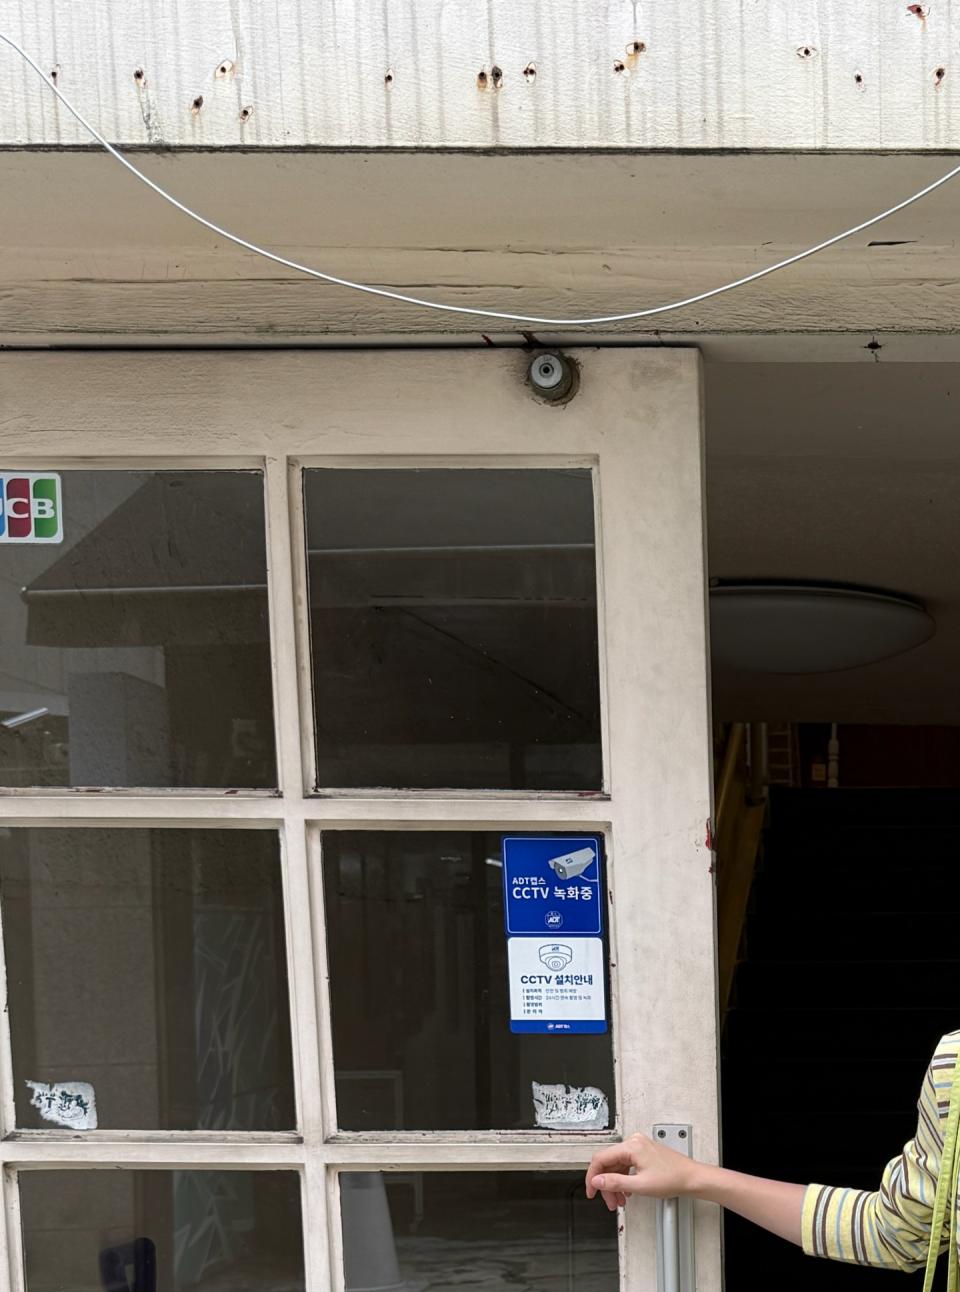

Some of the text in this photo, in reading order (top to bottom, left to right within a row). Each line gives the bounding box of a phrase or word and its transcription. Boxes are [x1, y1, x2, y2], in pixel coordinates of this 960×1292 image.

[0, 497, 55, 519] CB
[512, 886, 593, 900] CCTV 녹화중
[520, 974, 593, 986] CCTV 설치안내
